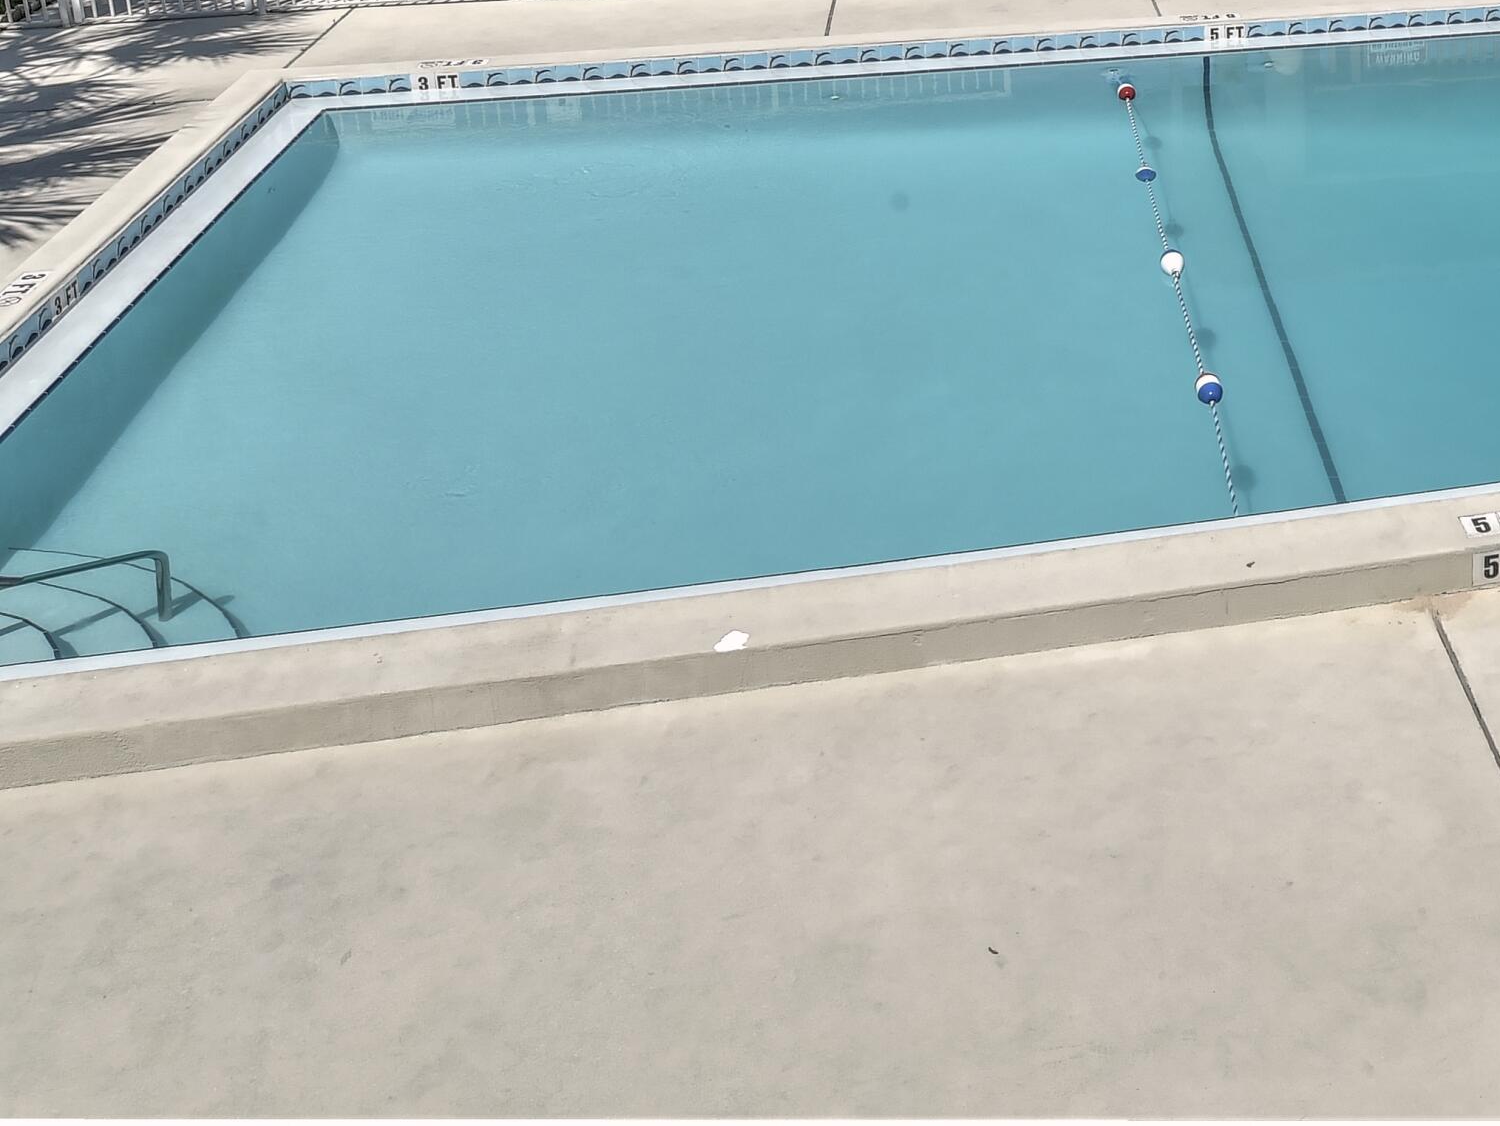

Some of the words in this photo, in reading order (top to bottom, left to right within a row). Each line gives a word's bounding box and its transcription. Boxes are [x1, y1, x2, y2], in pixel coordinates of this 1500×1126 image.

[1210, 28, 1219, 40] 5
[417, 77, 429, 90] 3
[54, 296, 62, 315] 3
[65, 280, 78, 306] FT
[1471, 516, 1491, 533] 5
[1484, 554, 1499, 579] 5
